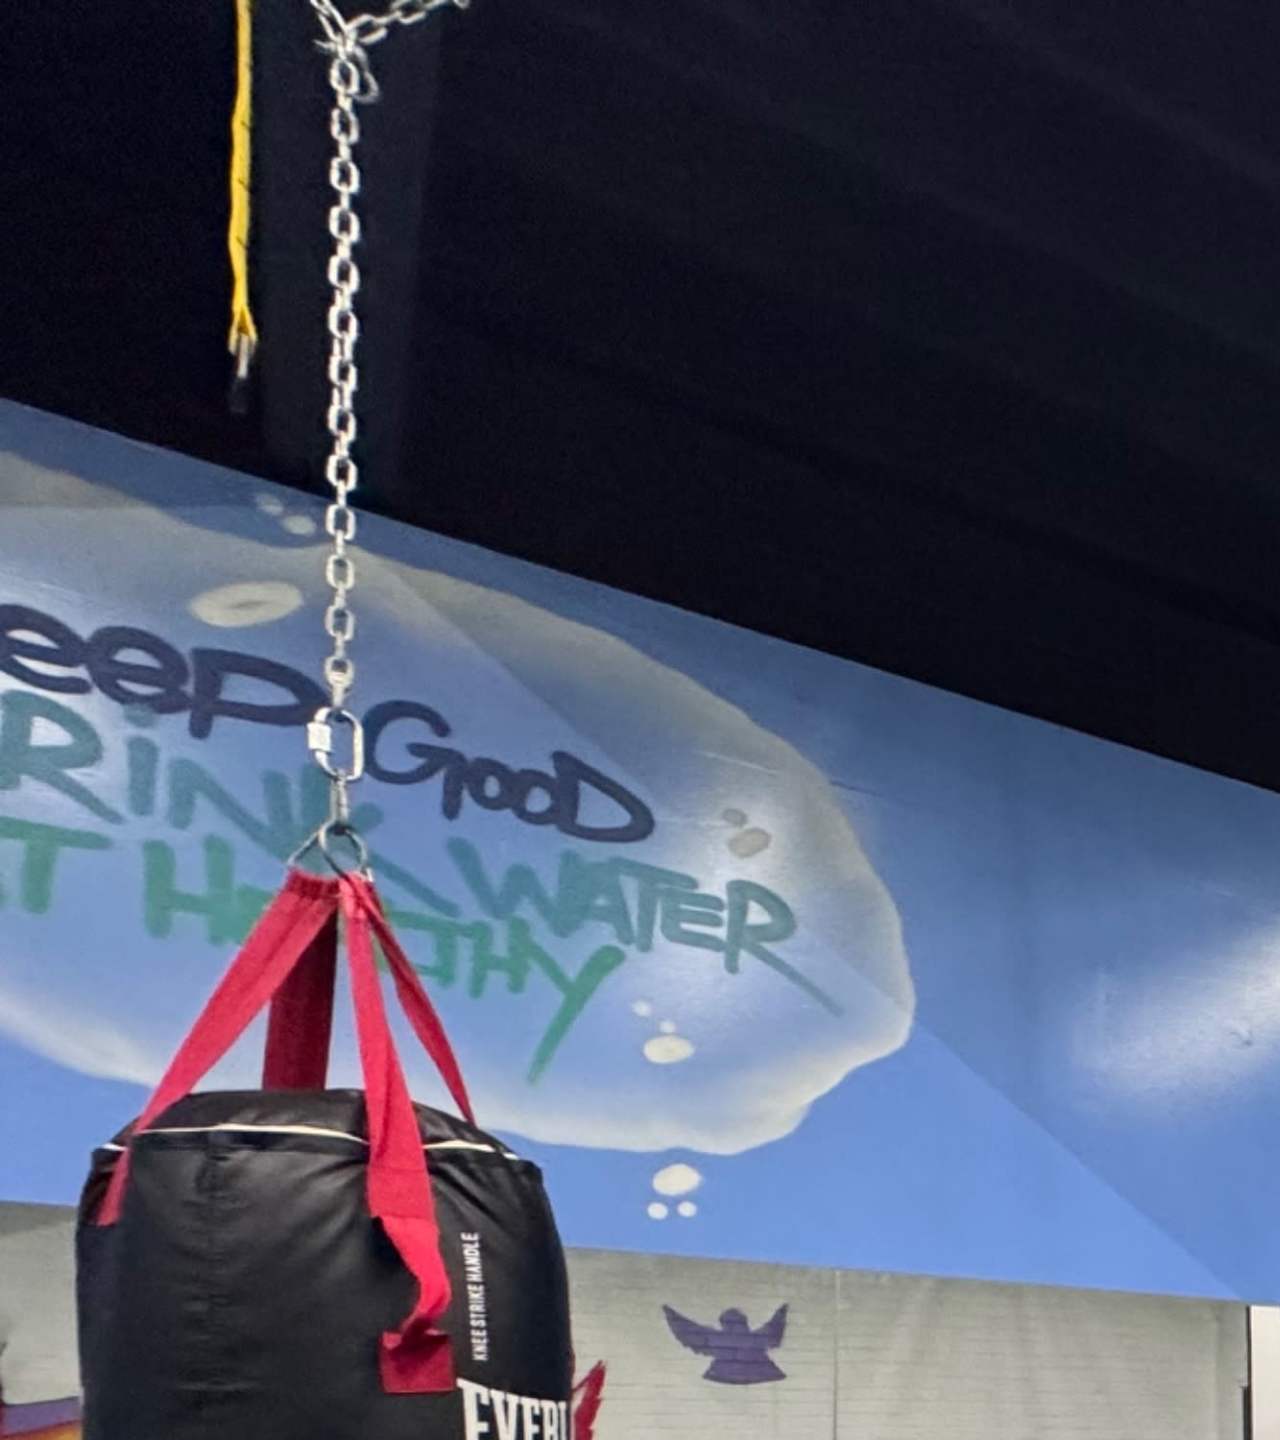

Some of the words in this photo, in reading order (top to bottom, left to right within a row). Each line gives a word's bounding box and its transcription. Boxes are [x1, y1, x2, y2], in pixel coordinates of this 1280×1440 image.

[447, 838, 843, 1018] WATER
[461, 1231, 484, 1282] HANDLE
[467, 1284, 488, 1326] STRIKE
[472, 1327, 489, 1361] KNEE
